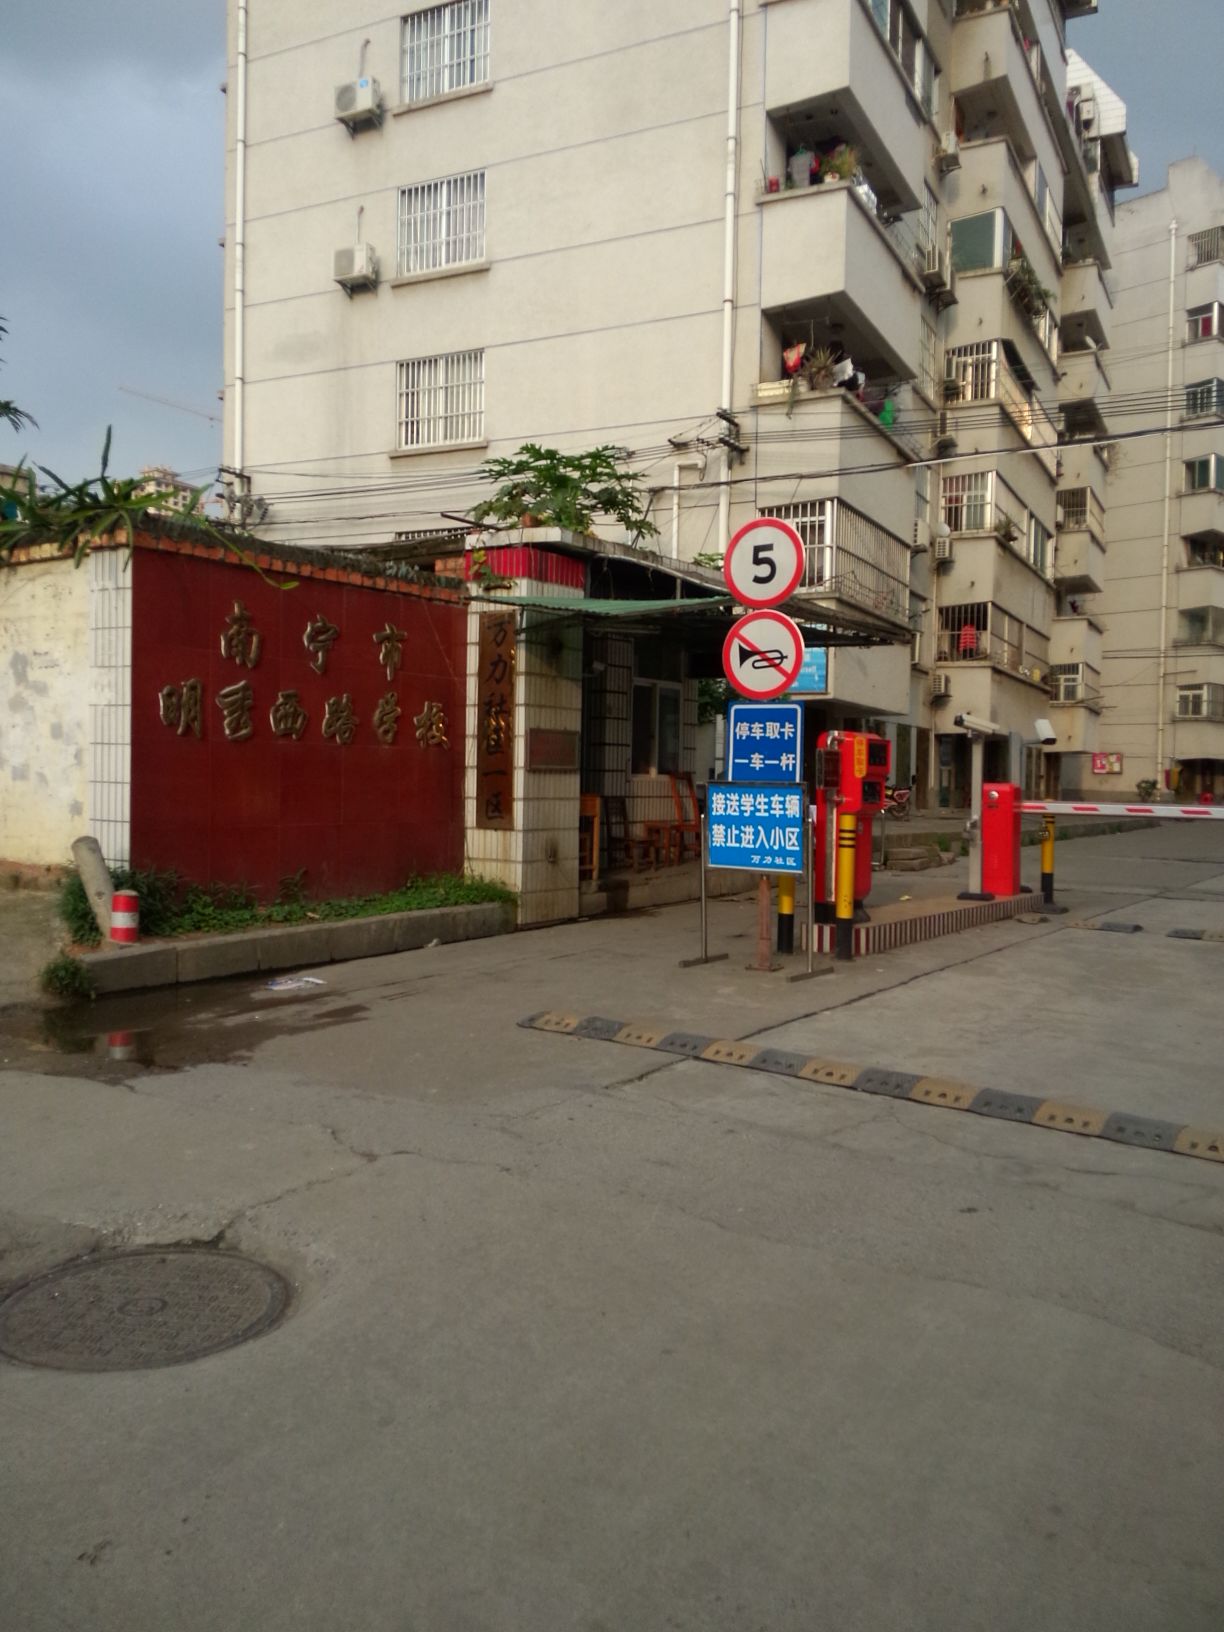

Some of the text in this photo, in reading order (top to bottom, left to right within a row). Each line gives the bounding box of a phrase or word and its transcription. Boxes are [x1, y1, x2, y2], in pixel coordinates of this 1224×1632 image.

[751, 543, 777, 585] 5
[220, 599, 407, 681] 南宁市
[735, 721, 795, 740] 停车取卡
[734, 752, 796, 771] 一车一杆
[711, 792, 800, 818] 接送学生车辆
[711, 823, 800, 850] 禁止进入小区
[750, 854, 797, 866] 万力社区
